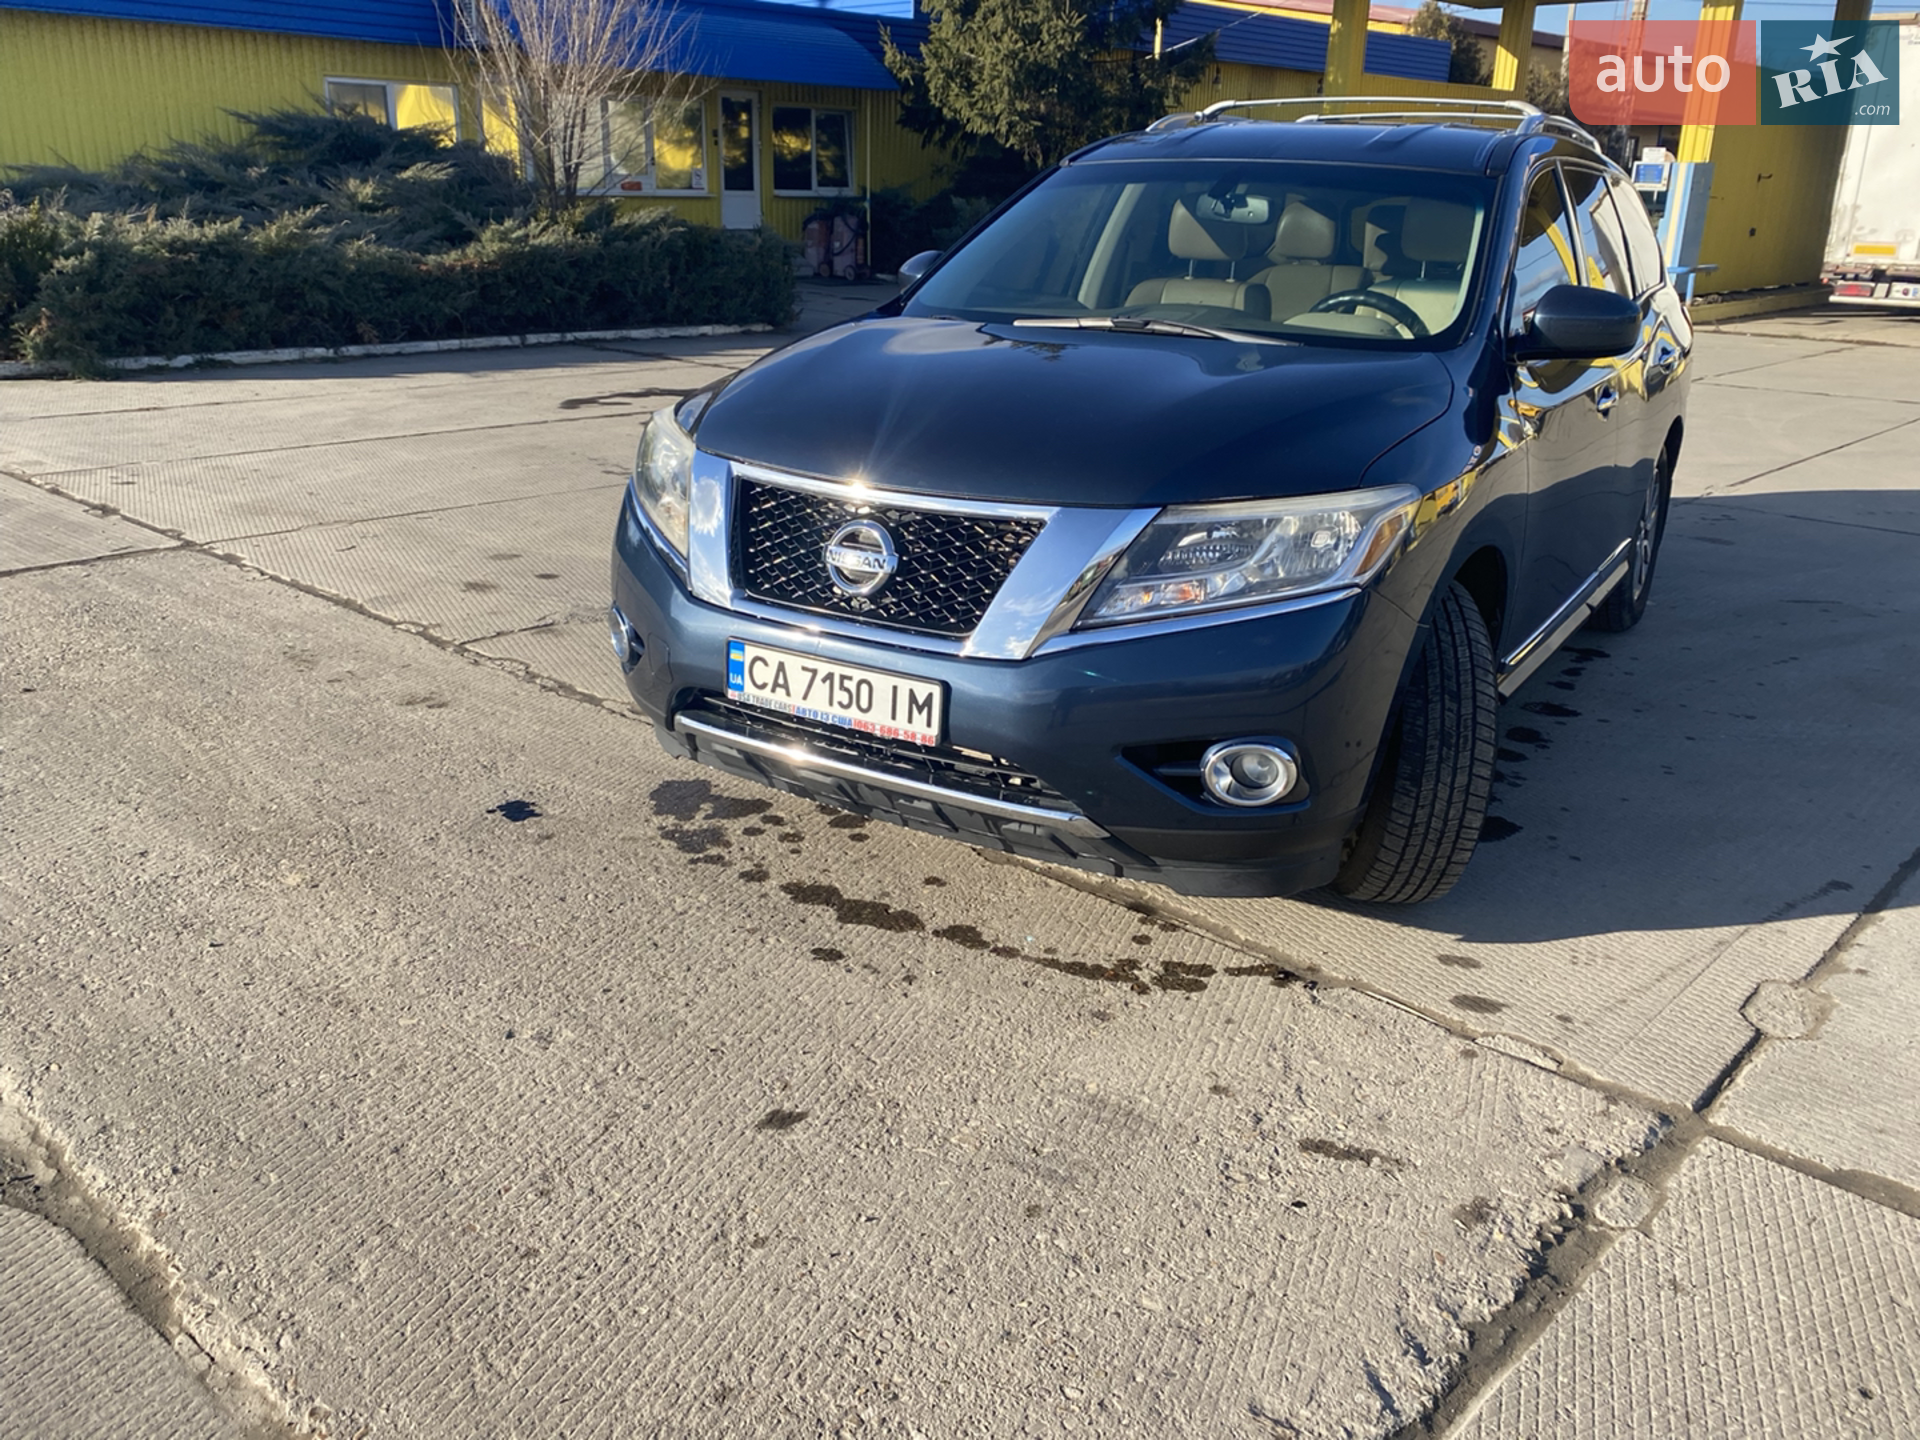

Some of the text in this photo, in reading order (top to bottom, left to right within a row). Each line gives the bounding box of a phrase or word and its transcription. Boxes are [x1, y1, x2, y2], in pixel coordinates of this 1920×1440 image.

[827, 549, 886, 570] NIAN
[729, 672, 744, 686] UA
[748, 655, 934, 729] CA 7150 IM
